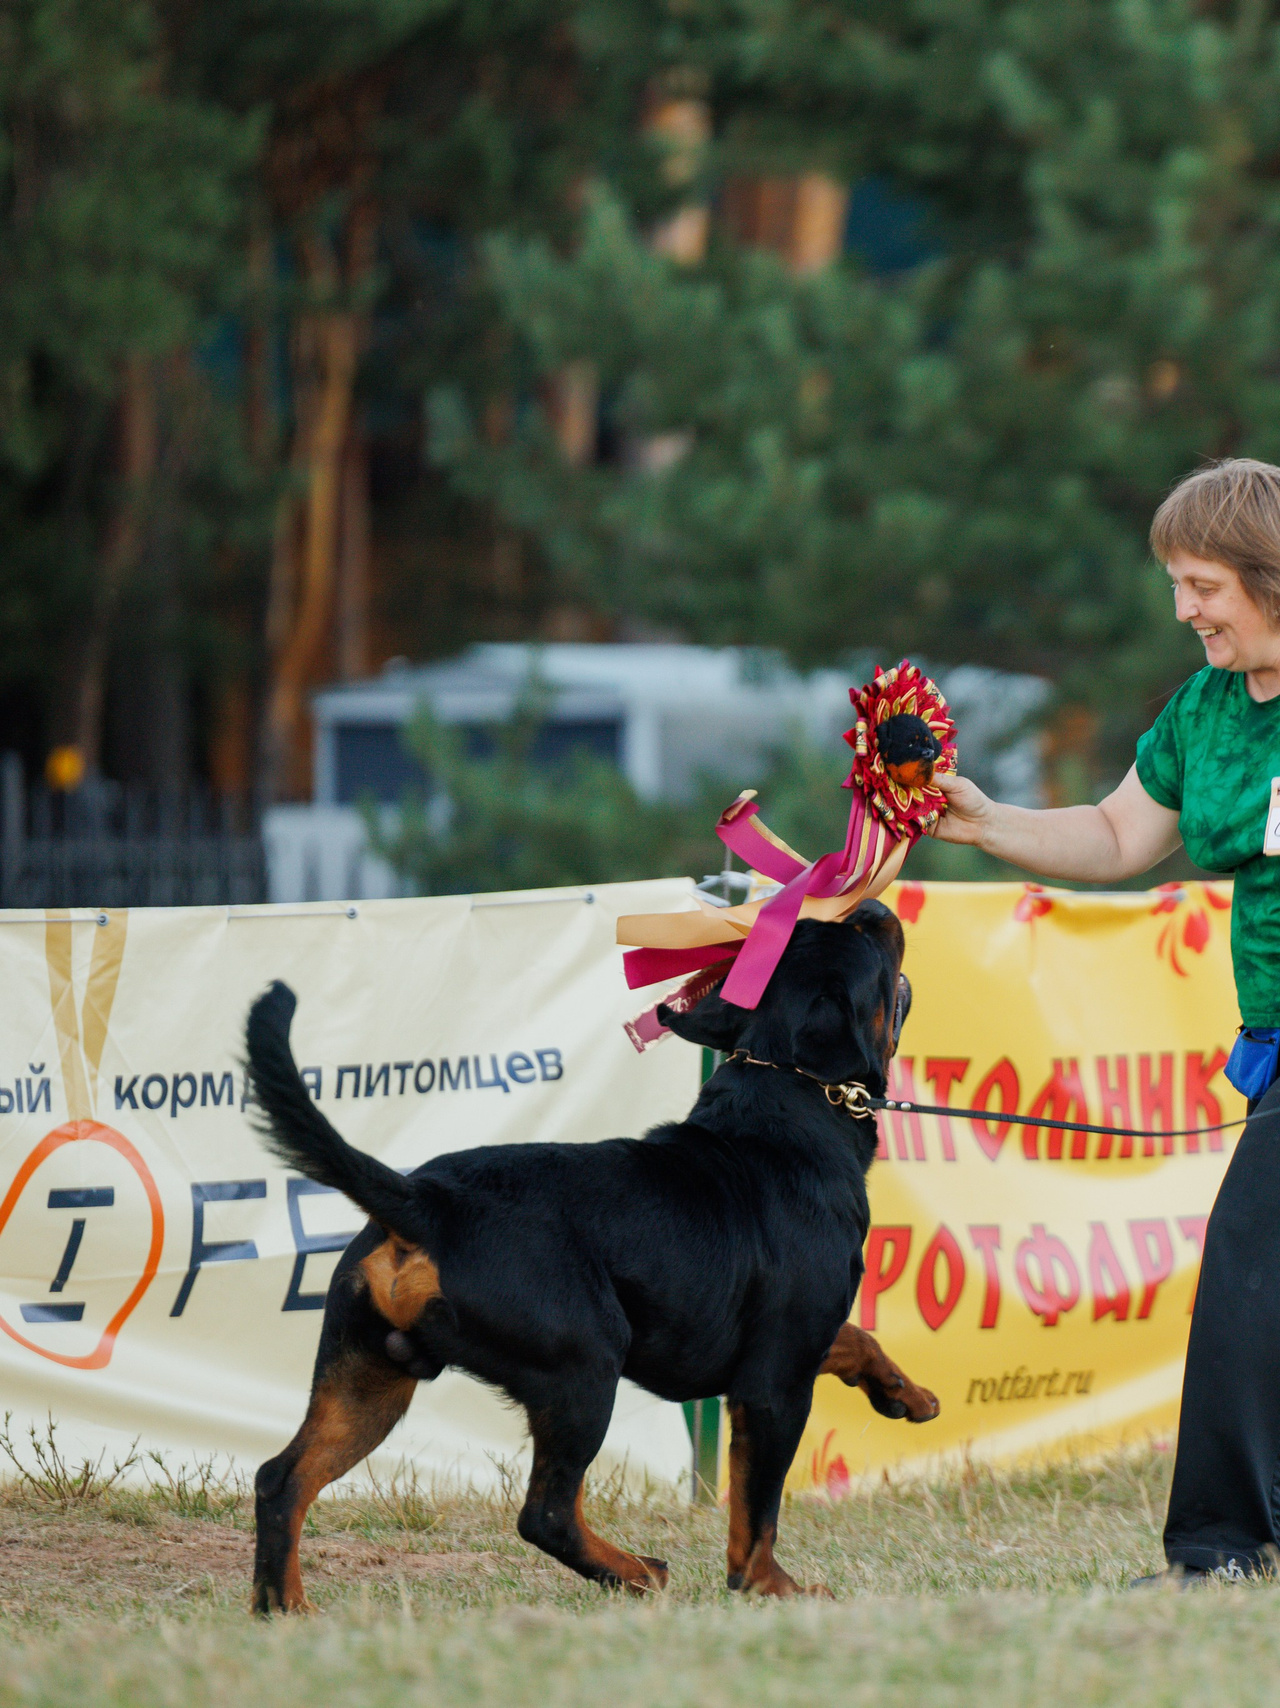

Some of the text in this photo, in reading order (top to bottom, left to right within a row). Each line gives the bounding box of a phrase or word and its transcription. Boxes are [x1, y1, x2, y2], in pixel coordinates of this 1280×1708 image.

[114, 1071, 234, 1118] корм
[335, 1047, 563, 1099] питомцев
[966, 1365, 1095, 1405] rotfart.ru
